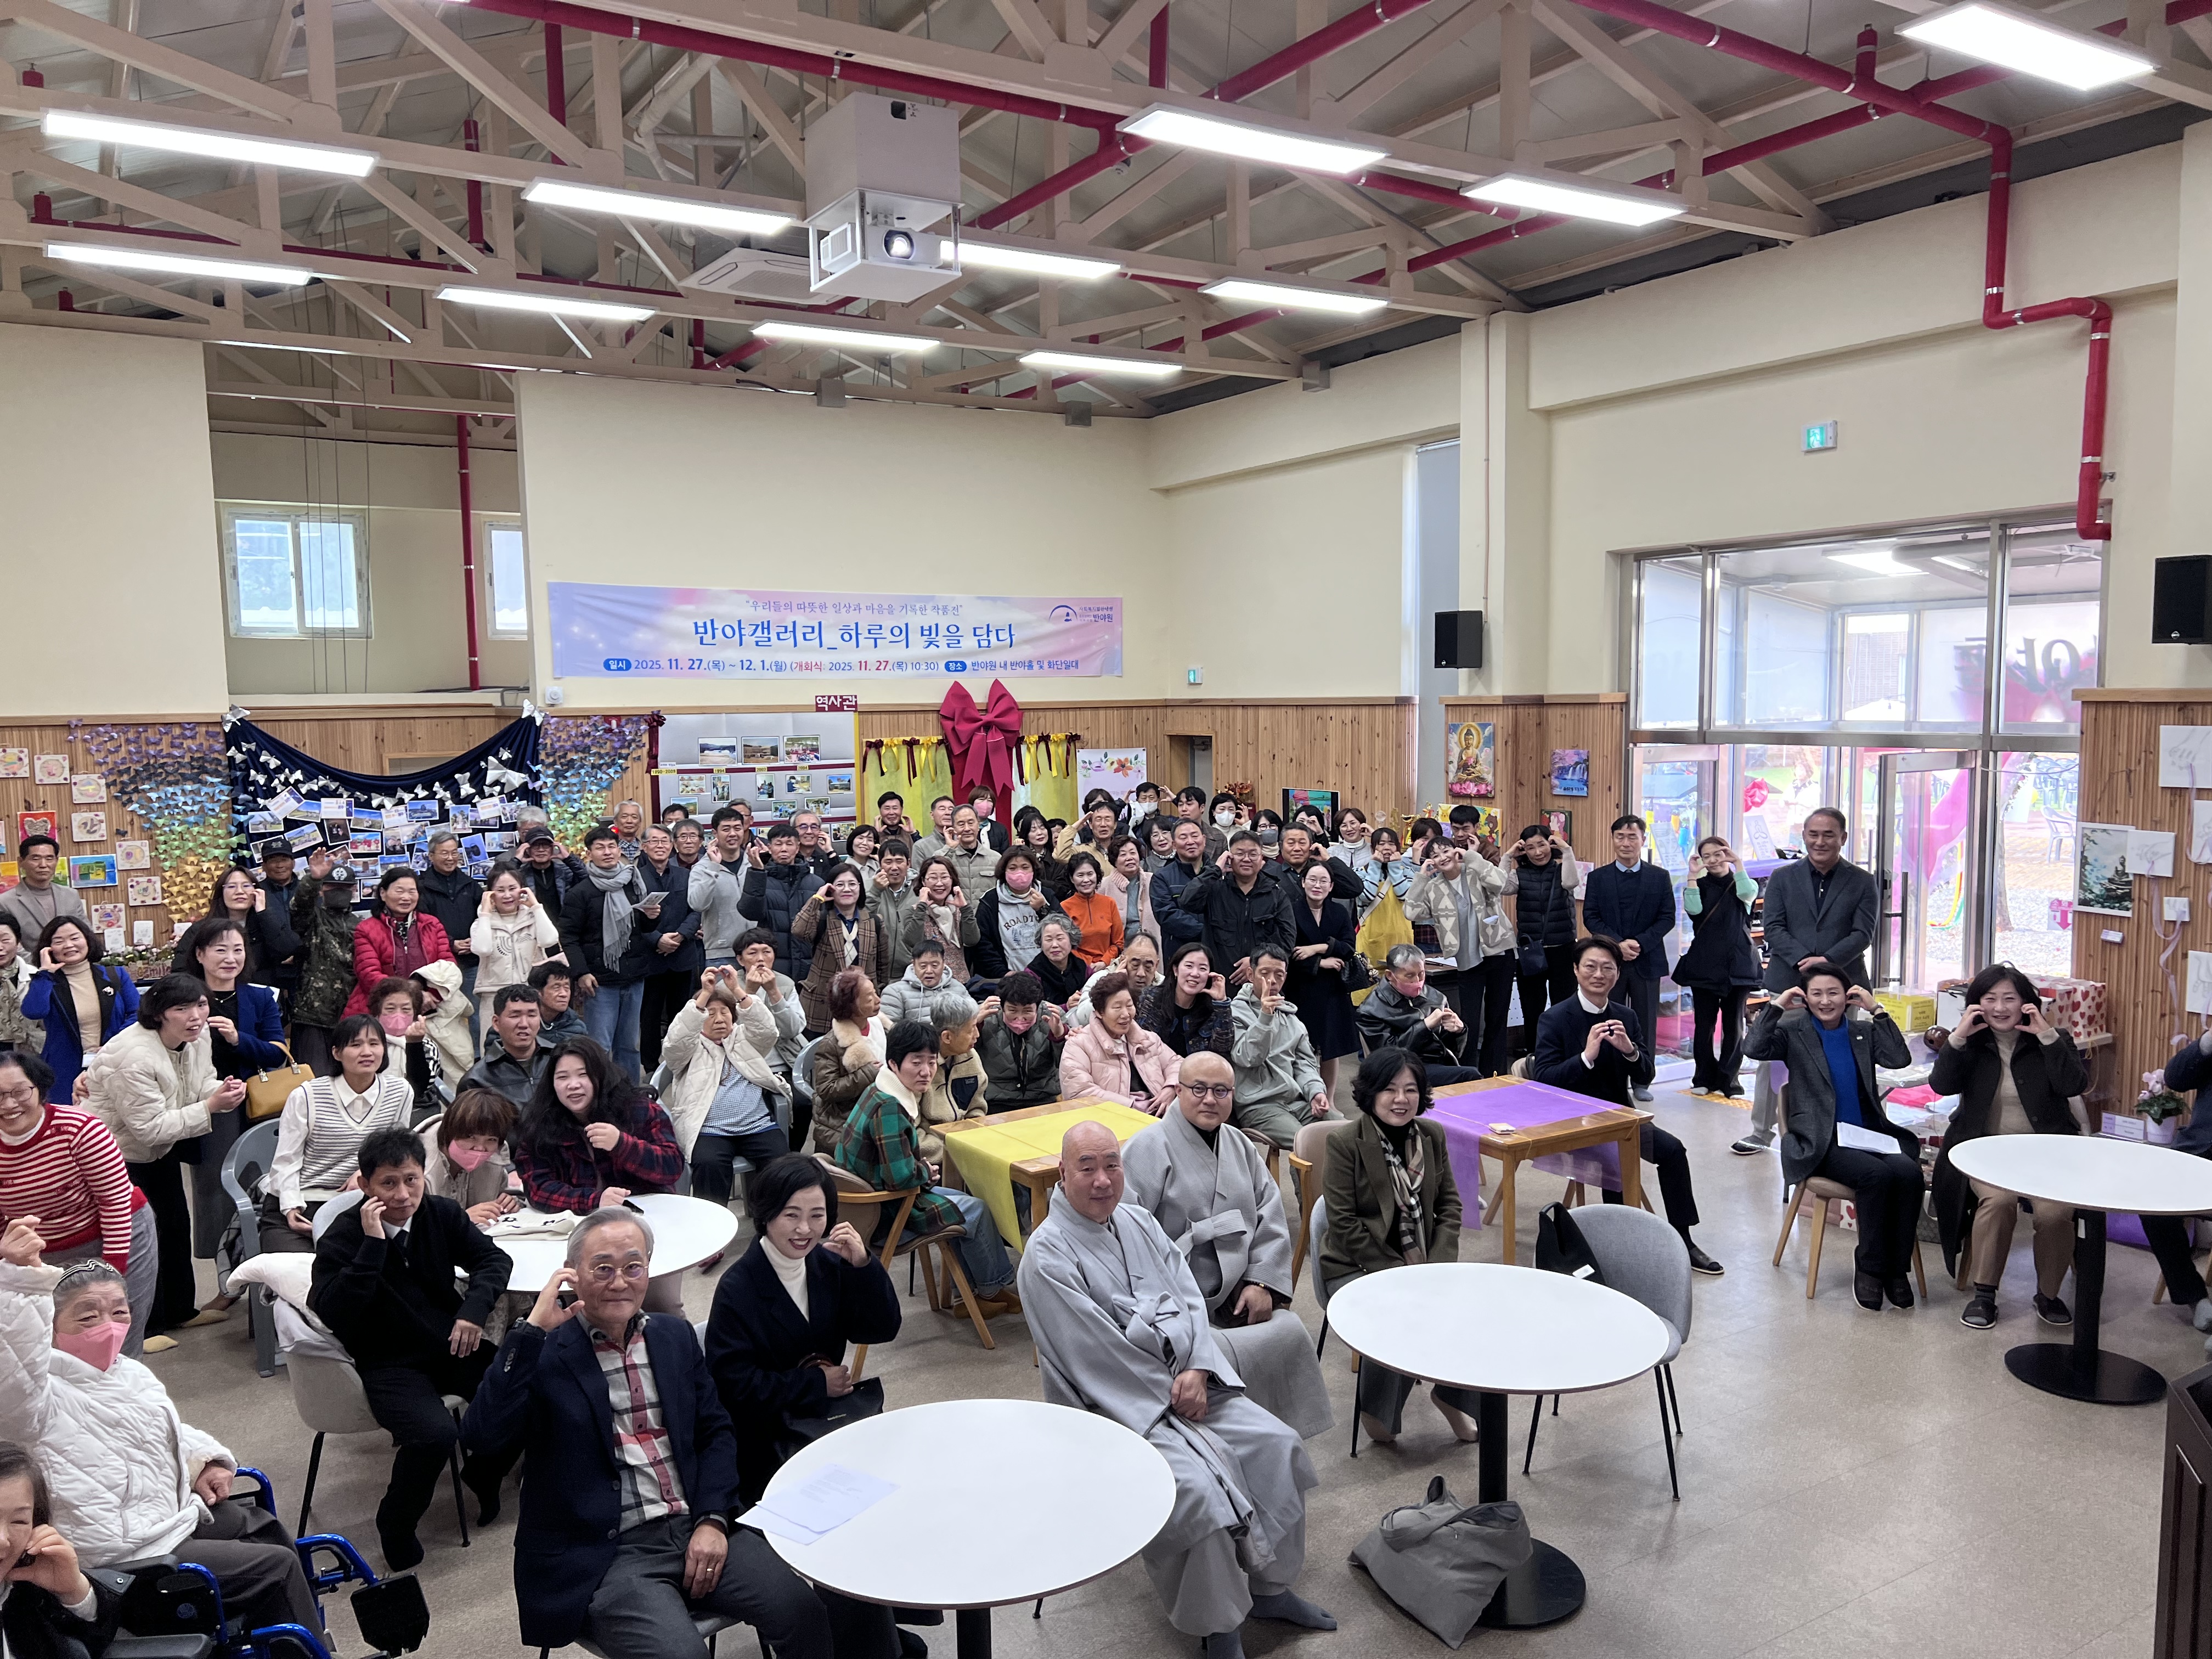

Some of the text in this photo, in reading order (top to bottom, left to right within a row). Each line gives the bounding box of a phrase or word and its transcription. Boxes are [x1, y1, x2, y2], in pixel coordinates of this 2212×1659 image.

[797, 601, 828, 613] 따뜻한
[832, 602, 862, 614] 일상과
[865, 603, 895, 614] 마음을
[899, 603, 928, 616] 기록한
[1093, 613, 1113, 623] 반야원
[919, 622, 964, 649] 빛을
[972, 623, 1015, 649] 담다
[608, 659, 627, 670] 일시
[634, 659, 664, 670] 2025.
[668, 658, 683, 670] 11.
[739, 659, 756, 671] 12.
[790, 661, 825, 673] (개회식:
[828, 662, 855, 671] 2025.
[858, 660, 871, 672] 11.
[911, 661, 939, 672] 10:30)
[948, 662, 963, 670] 장소
[971, 661, 996, 671] 반야원
[999, 661, 1007, 671] 내
[1010, 659, 1034, 670] 반야홀
[1036, 659, 1045, 670] 및
[1047, 659, 1079, 670] 화단일대
[816, 695, 857, 711] 역사관
